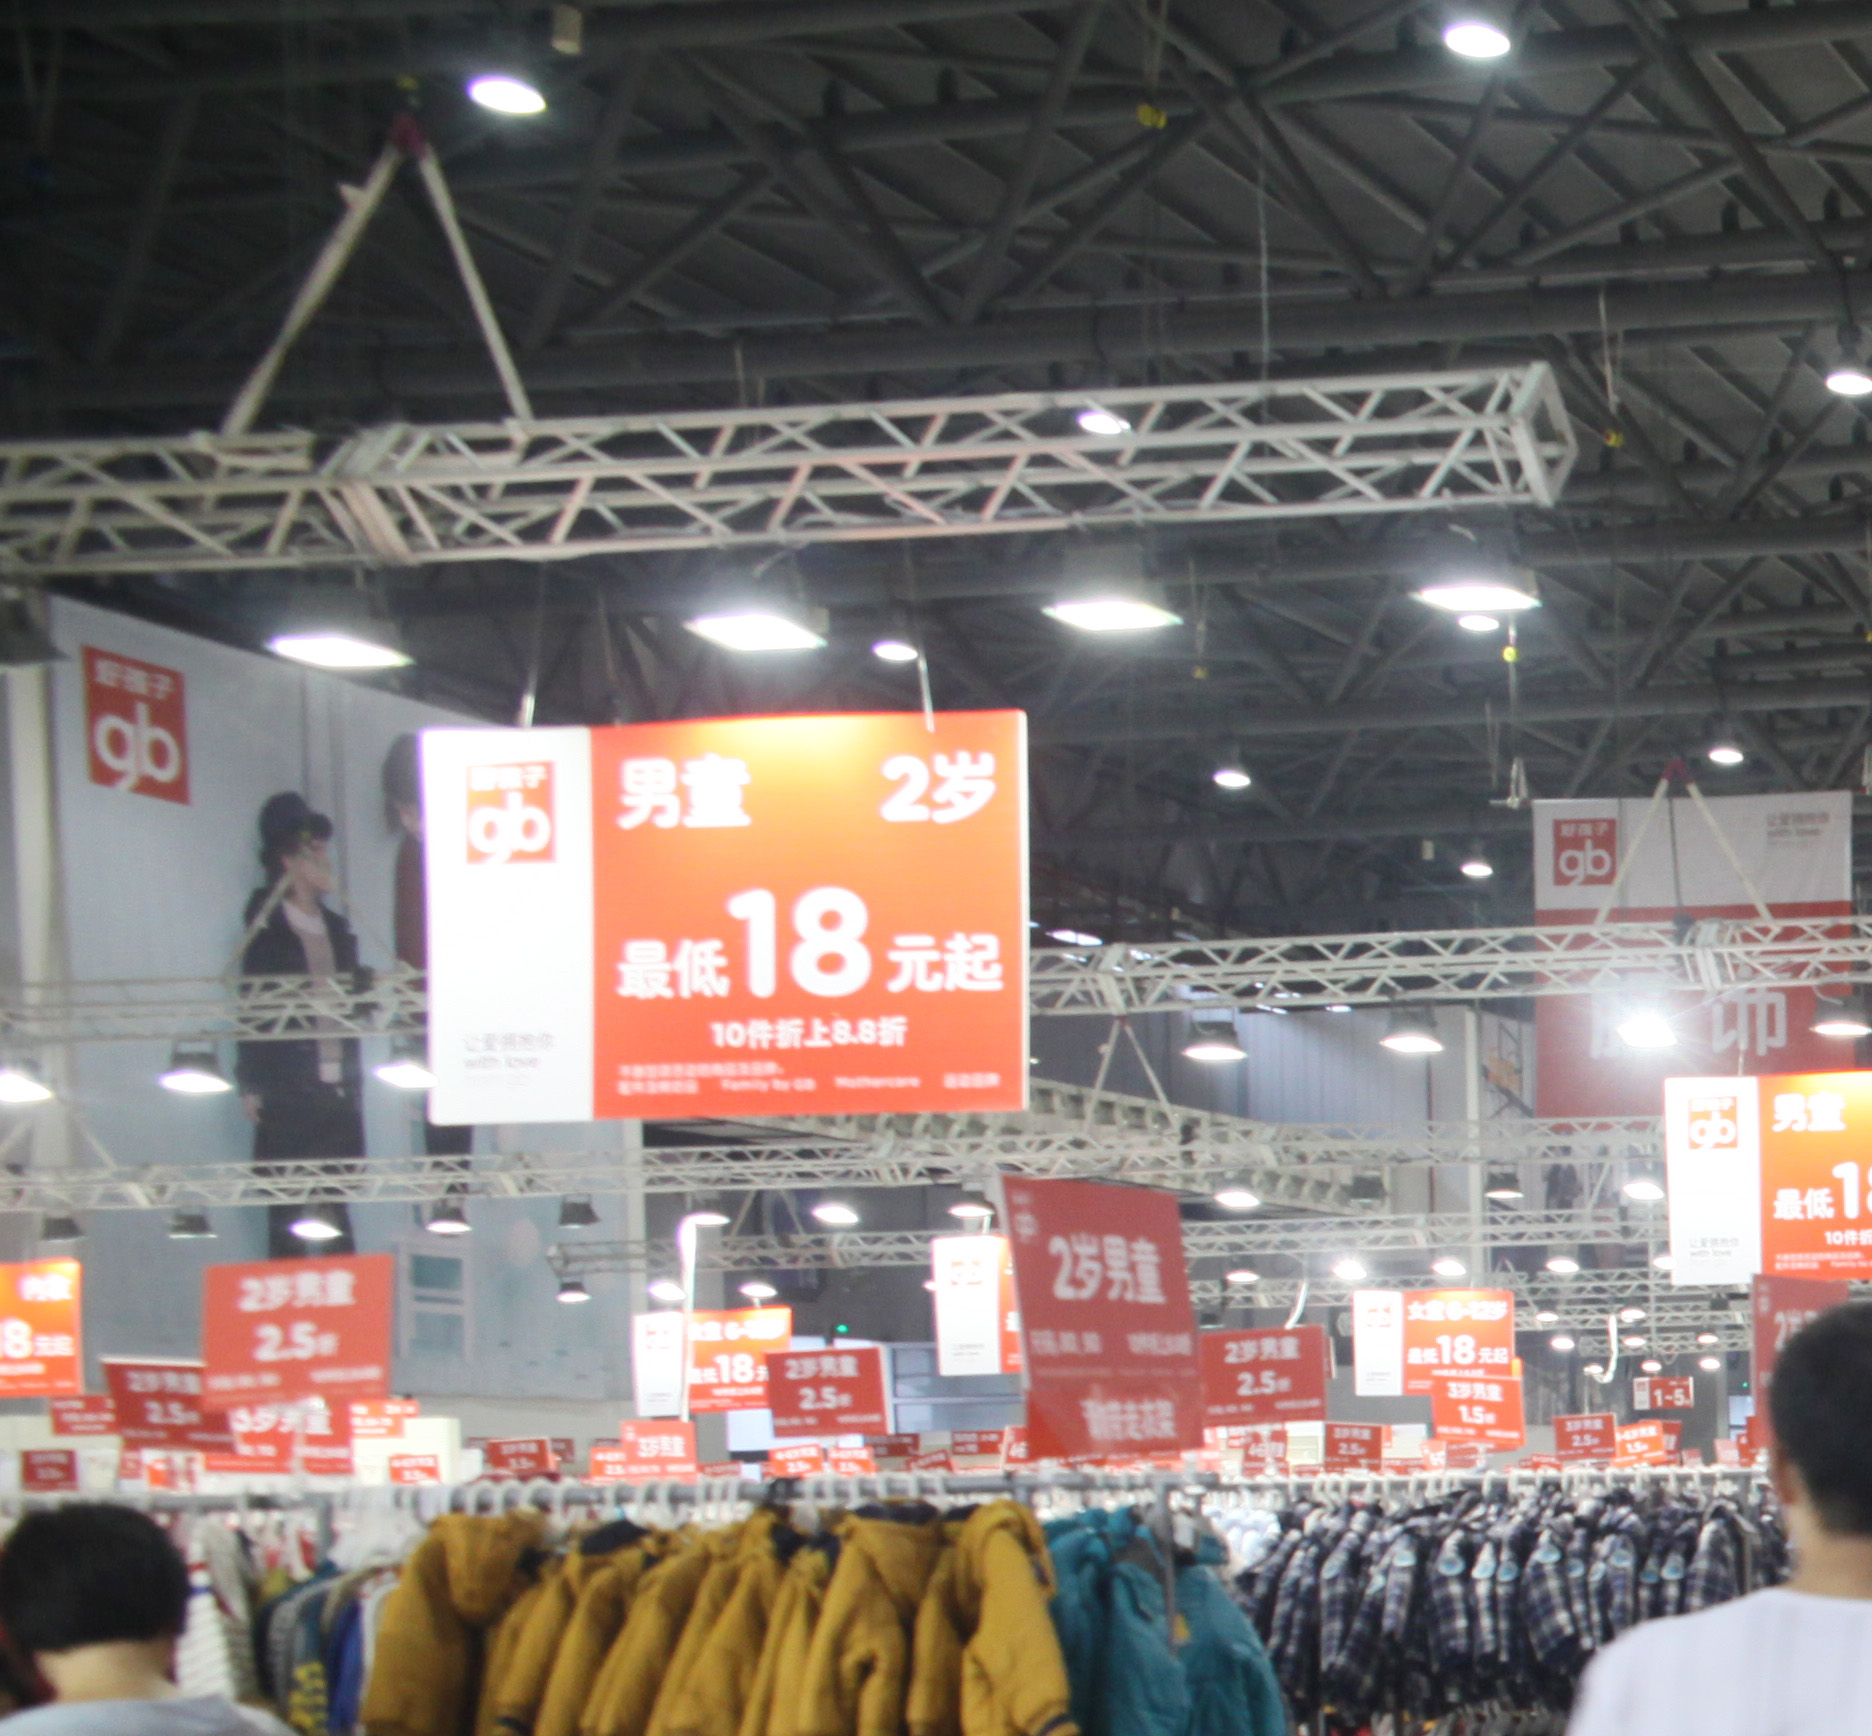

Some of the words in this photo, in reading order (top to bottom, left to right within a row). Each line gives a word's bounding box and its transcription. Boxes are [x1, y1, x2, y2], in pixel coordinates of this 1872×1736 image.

[93, 702, 180, 791] gb
[468, 791, 550, 863] gb
[617, 753, 751, 831] 男童
[879, 752, 996, 826] 2岁
[1559, 838, 1612, 886] gb
[616, 887, 1004, 1000] 最低18元起
[711, 1016, 909, 1050] 10件折上8.8折
[1689, 1111, 1737, 1149] gb
[1772, 1091, 1847, 1133] 男童
[1047, 1232, 1167, 1305] 2岁男童
